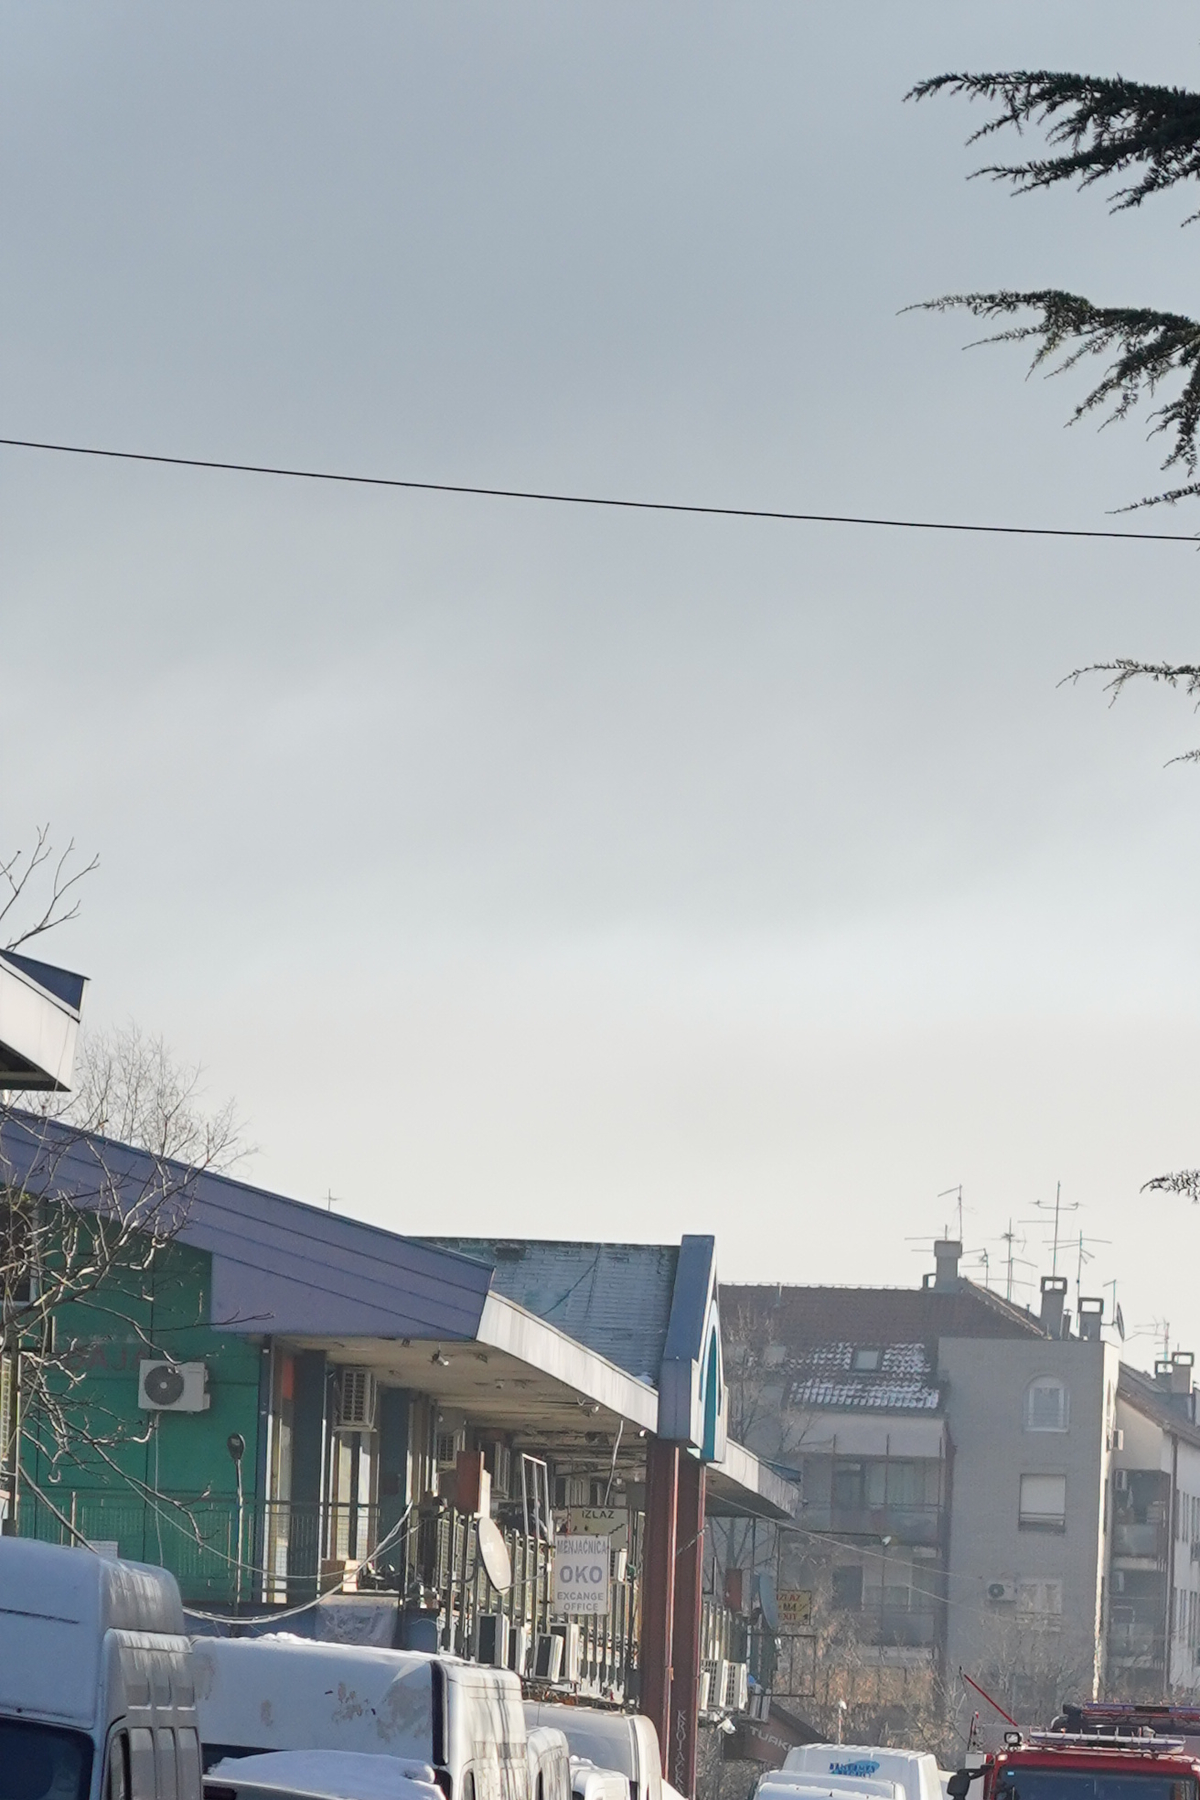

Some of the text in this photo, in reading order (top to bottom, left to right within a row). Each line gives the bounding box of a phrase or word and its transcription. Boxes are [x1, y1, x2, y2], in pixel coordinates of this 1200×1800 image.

[581, 1510, 615, 1519] IZLAZ
[560, 1565, 603, 1584] OKO
[557, 1592, 604, 1601] EXCANGE
[563, 1602, 599, 1611] OFFICE
